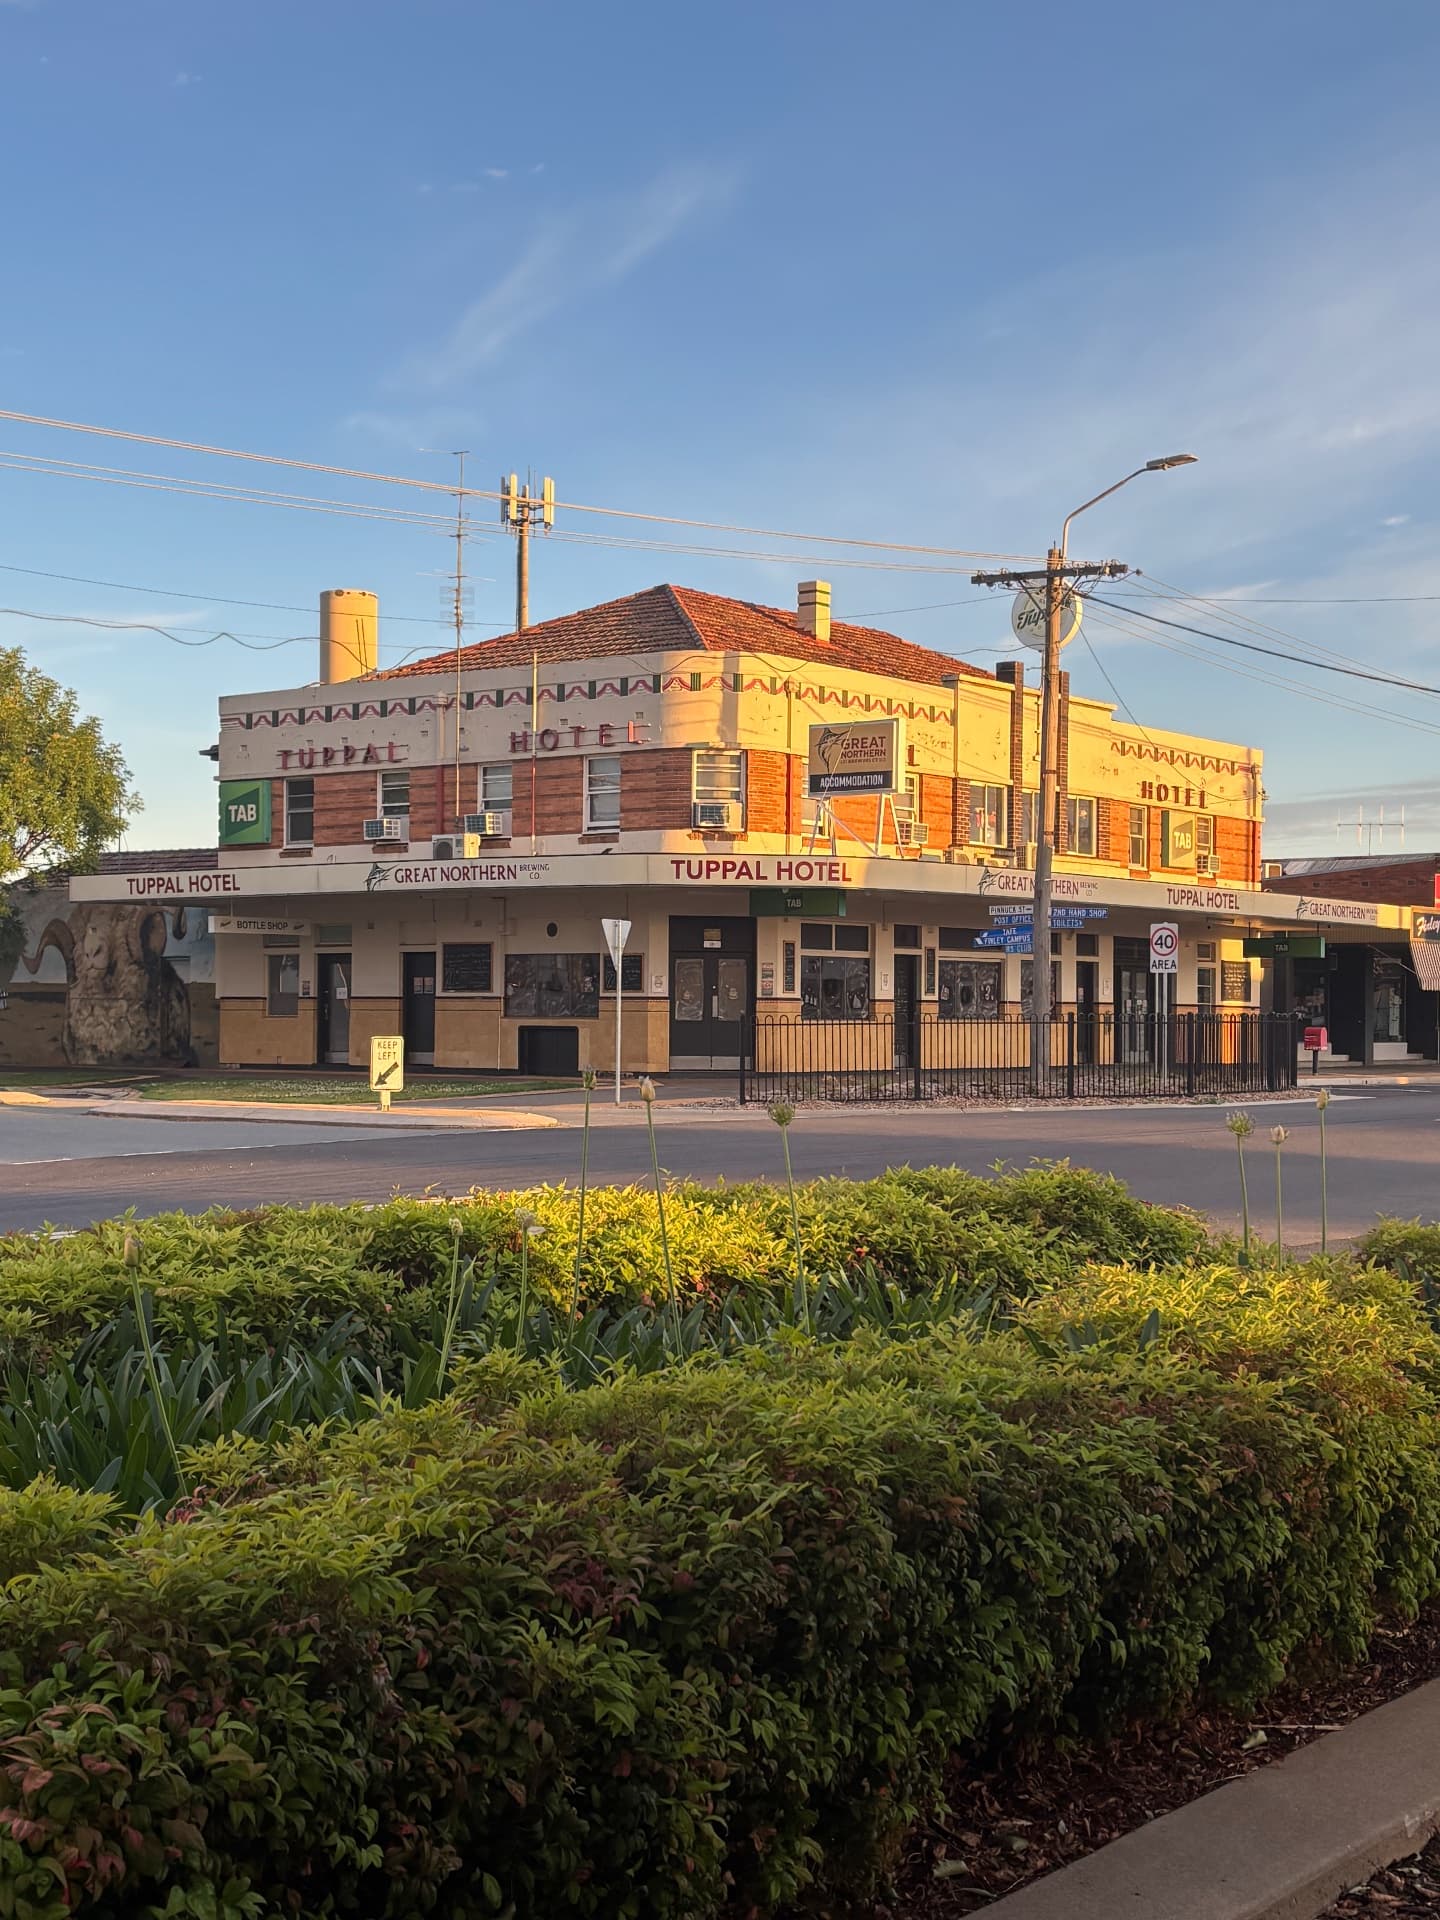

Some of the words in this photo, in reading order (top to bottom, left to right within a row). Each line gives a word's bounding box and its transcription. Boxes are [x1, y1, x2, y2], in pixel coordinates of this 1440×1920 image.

[510, 720, 646, 753] HOTEL
[841, 736, 886, 750] GREAT
[276, 742, 404, 770] TUPPAL
[841, 749, 886, 759] NORTHERN
[820, 774, 884, 788] ACCOMMODATION
[1140, 780, 1208, 809] HOTEL
[228, 804, 257, 822] TAB
[1174, 831, 1192, 849] TAB
[394, 866, 438, 883] GREAT
[440, 864, 517, 881] NORTHERN
[519, 863, 550, 872] BREWING
[670, 859, 768, 880] TUPPAL
[776, 861, 852, 882] HOTEL
[127, 876, 184, 895] TUPPAL
[189, 874, 241, 892] HOTEL
[998, 875, 1028, 891] GREAT
[1027, 877, 1079, 896] NTHERN
[1167, 887, 1205, 907] TUPPAL
[1207, 891, 1240, 910] HOTEL
[1069, 908, 1087, 917] HAND
[1088, 909, 1107, 918] SHOP
[1310, 902, 1331, 916] GREAT
[1332, 905, 1366, 919] NORTHERN
[237, 920, 266, 930] BOTTLE
[267, 921, 289, 930] SHOP
[1011, 915, 1032, 923] OFFICE
[1006, 935, 1031, 944] CAMPUS
[1154, 934, 1174, 949] 40
[1151, 959, 1177, 970] AREA
[377, 1040, 398, 1049] KEEP
[377, 1051, 397, 1060] LEFT
